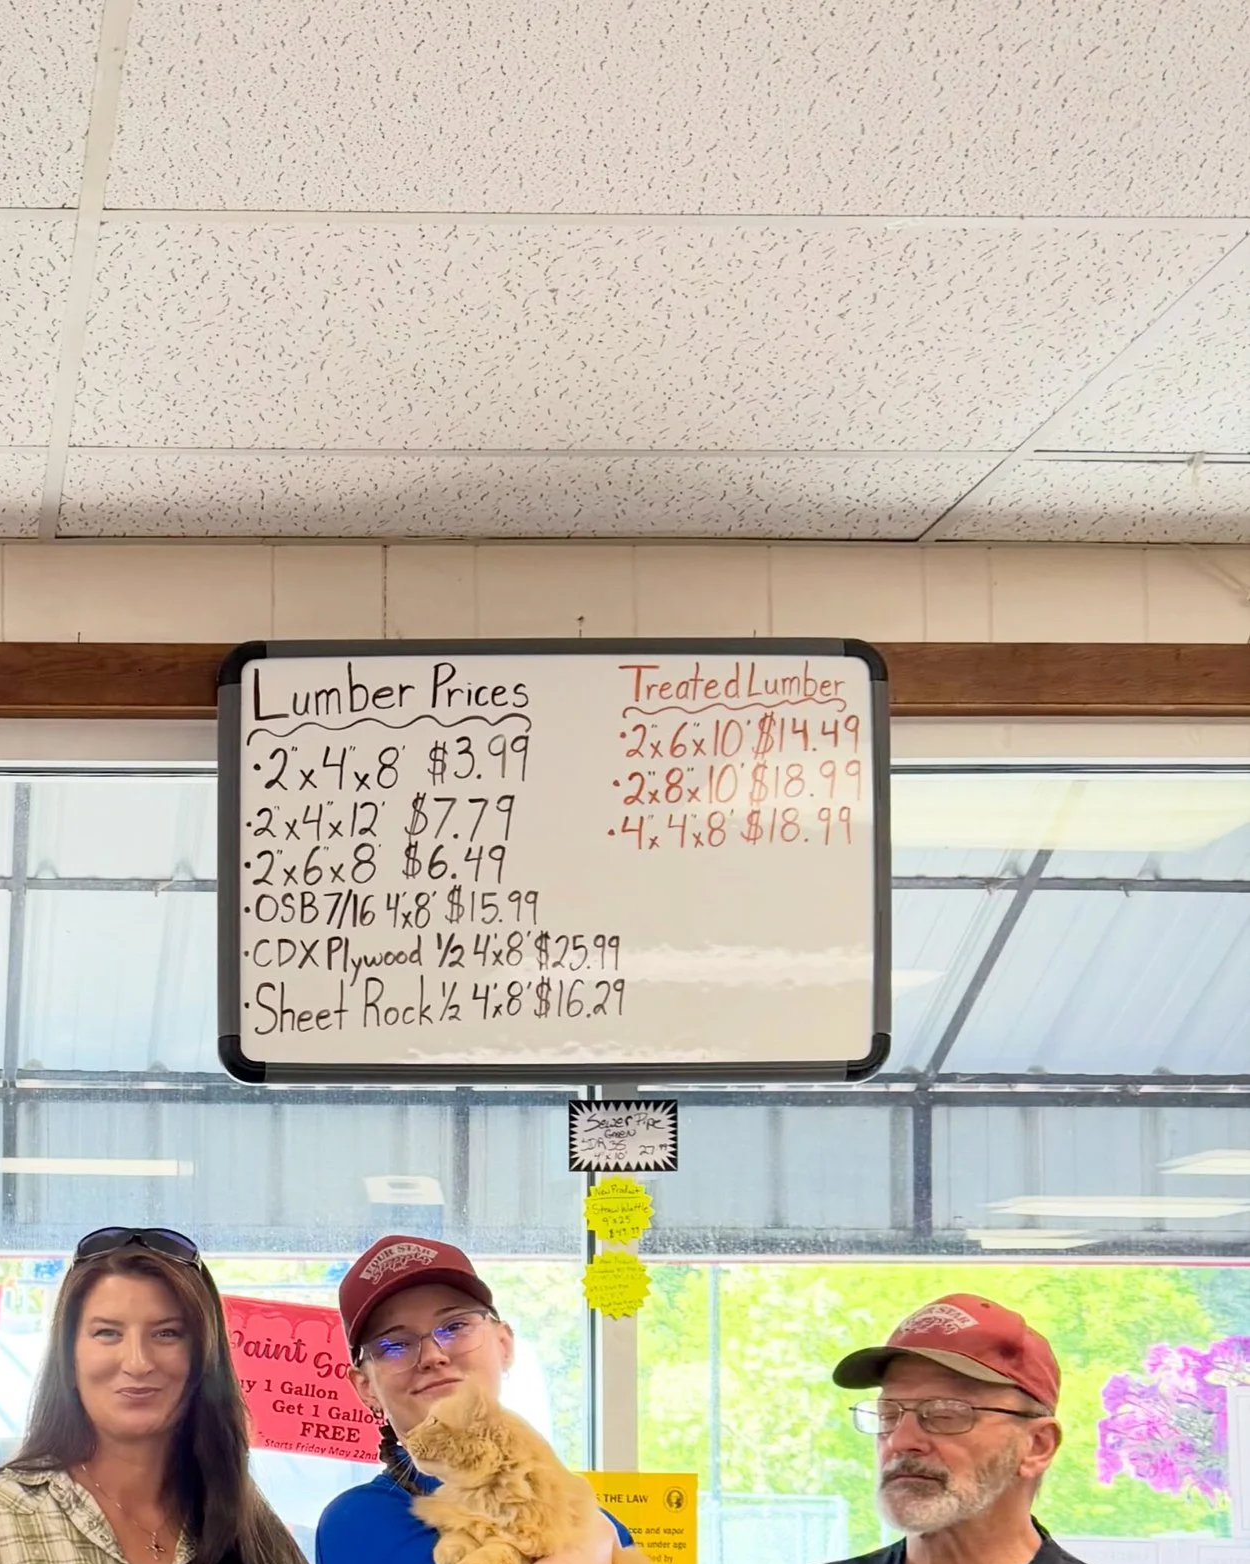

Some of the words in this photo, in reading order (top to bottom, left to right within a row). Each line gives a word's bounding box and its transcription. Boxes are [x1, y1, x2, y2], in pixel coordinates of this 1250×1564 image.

[254, 661, 415, 721] Lumber
[431, 662, 529, 708] Prices
[618, 662, 740, 702] Treated
[747, 660, 845, 697] Lumber
[752, 711, 860, 760] $14.49
[427, 734, 529, 786] $3.99
[750, 760, 862, 803] $18.99
[404, 792, 515, 842] $7.79
[740, 806, 852, 846] $18.99
[401, 840, 507, 884] $6.49
[254, 891, 320, 924] OSB
[323, 889, 376, 930] 7/16
[444, 885, 540, 925] $15.99
[253, 937, 320, 969] CDX
[326, 935, 423, 987] Plywood
[534, 930, 620, 971] $25.99
[253, 979, 349, 1036] Sheet
[363, 974, 434, 1028] Rock
[534, 976, 626, 1019] $16.29
[584, 1112, 633, 1132] Sewer
[635, 1112, 666, 1130] Pipe
[365, 1248, 394, 1274] FOUR
[396, 1244, 432, 1255] STAR
[264, 1379, 272, 1392] 1
[280, 1381, 339, 1401] Gallon
[272, 1399, 304, 1416] Get
[311, 1404, 321, 1418] 1
[265, 1438, 293, 1450] Starts
[295, 1442, 327, 1455] Friday
[328, 1446, 351, 1458] May
[353, 1449, 378, 1461] 22nd
[300, 1421, 361, 1443] FREE
[603, 1494, 623, 1503] THE
[626, 1494, 649, 1503] LAW
